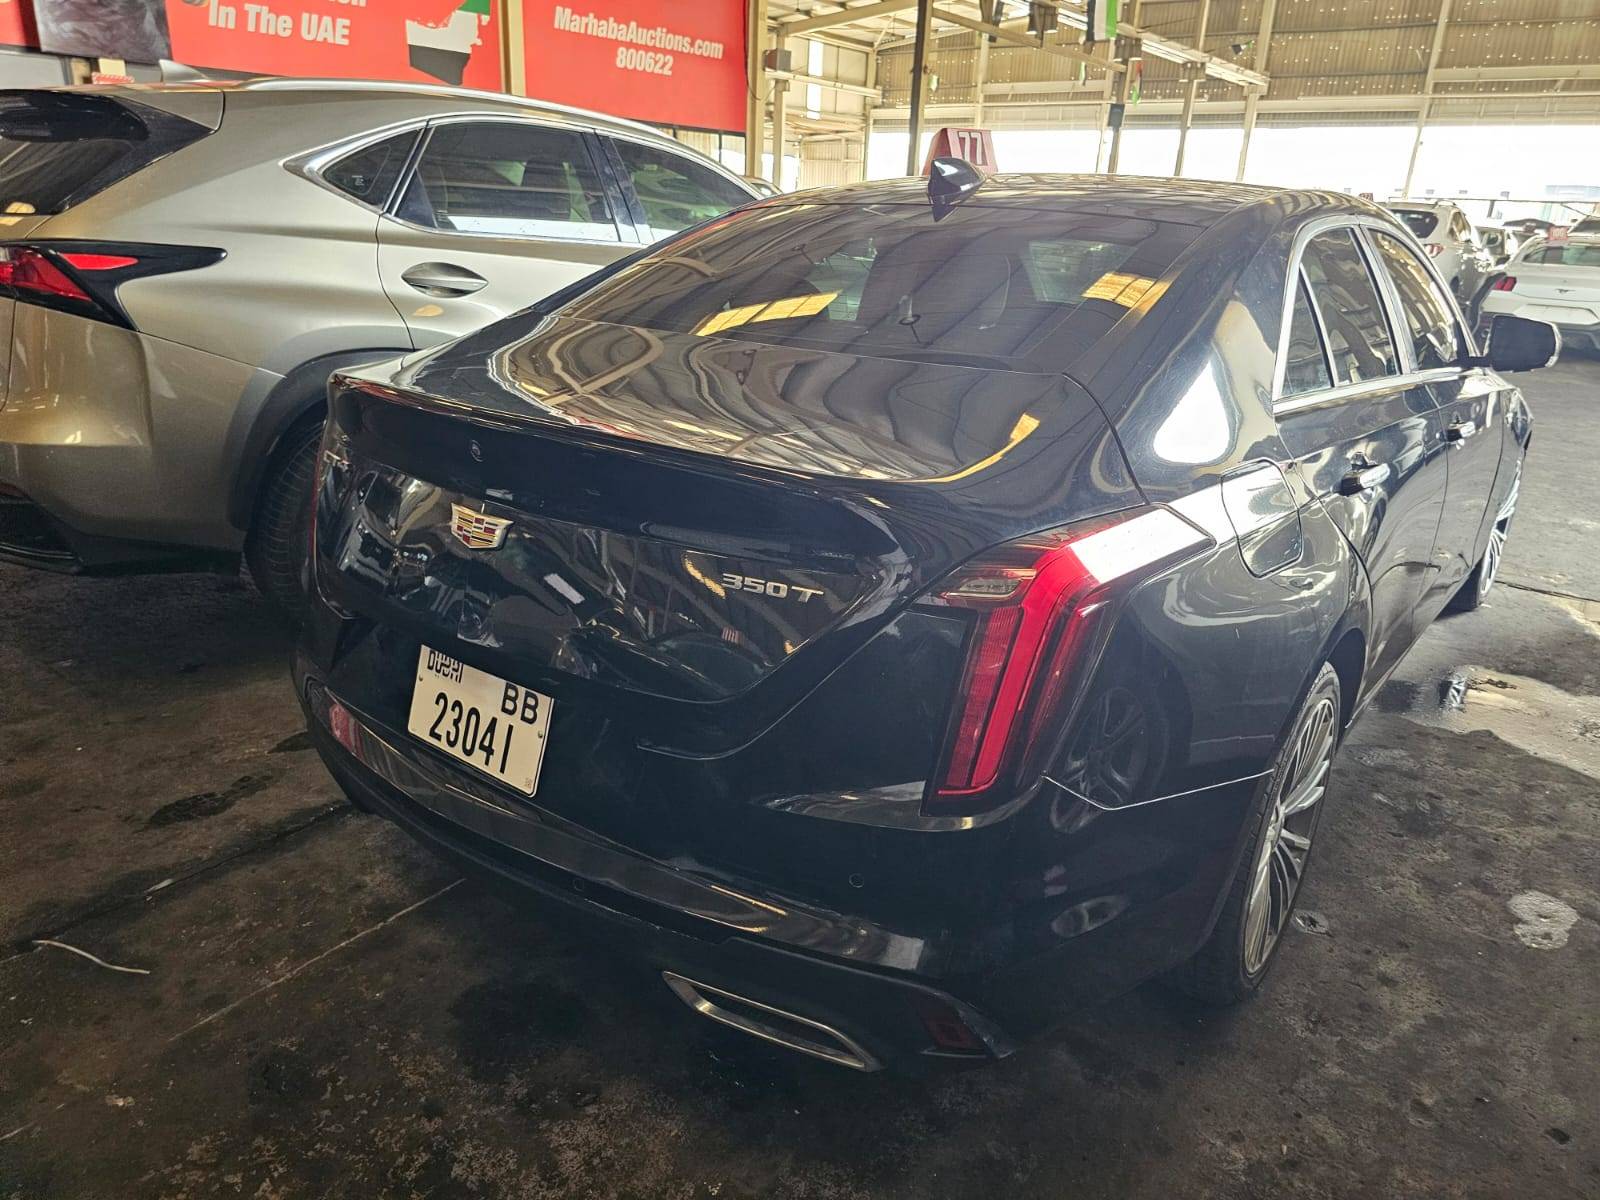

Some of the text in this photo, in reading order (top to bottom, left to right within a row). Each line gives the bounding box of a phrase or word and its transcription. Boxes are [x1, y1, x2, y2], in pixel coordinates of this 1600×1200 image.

[208, 0, 351, 46] In The UAE
[554, 6, 724, 60] MarhabaAuctions.com
[616, 47, 674, 76] 800622
[501, 682, 539, 724] BB
[429, 692, 514, 774] 23041
